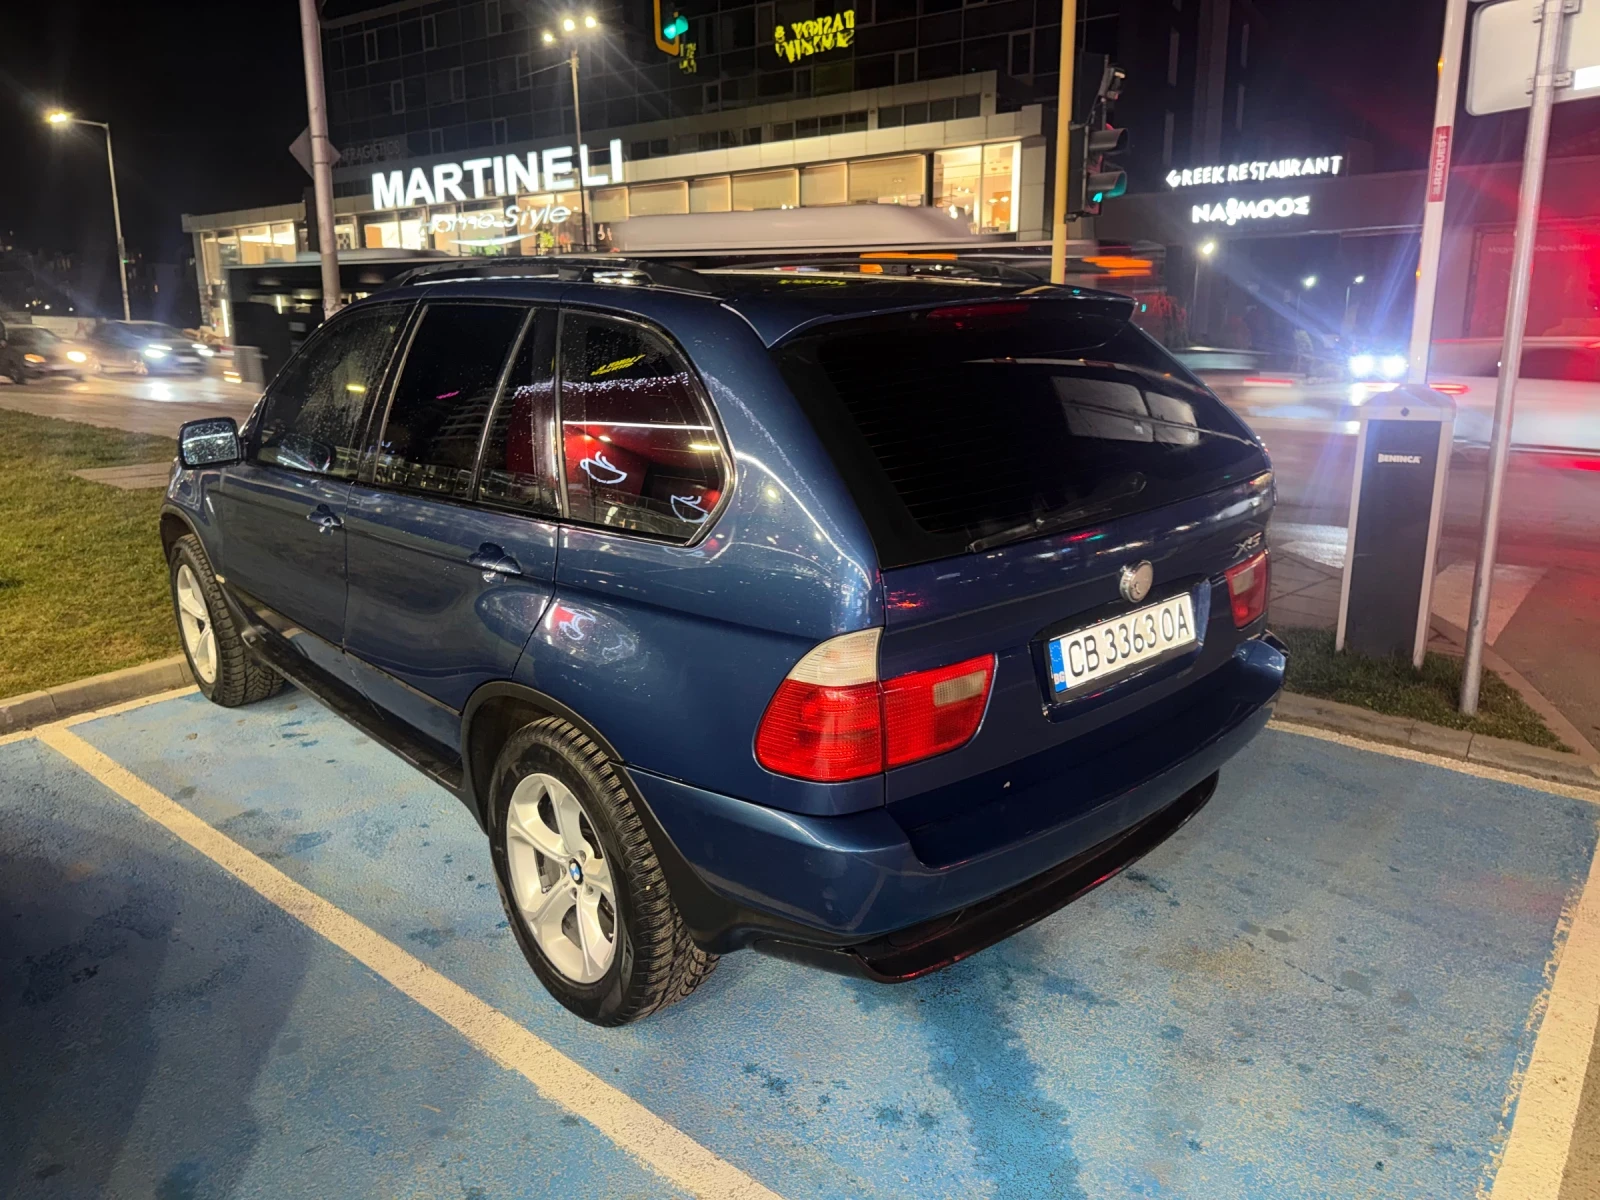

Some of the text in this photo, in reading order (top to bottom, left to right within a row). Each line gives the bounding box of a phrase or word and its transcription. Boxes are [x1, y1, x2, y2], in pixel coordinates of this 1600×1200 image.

[371, 138, 623, 211] MARTINELI
[1165, 155, 1344, 188] GREEK RESTAURANT
[1068, 603, 1190, 678] CB 3363 OA
